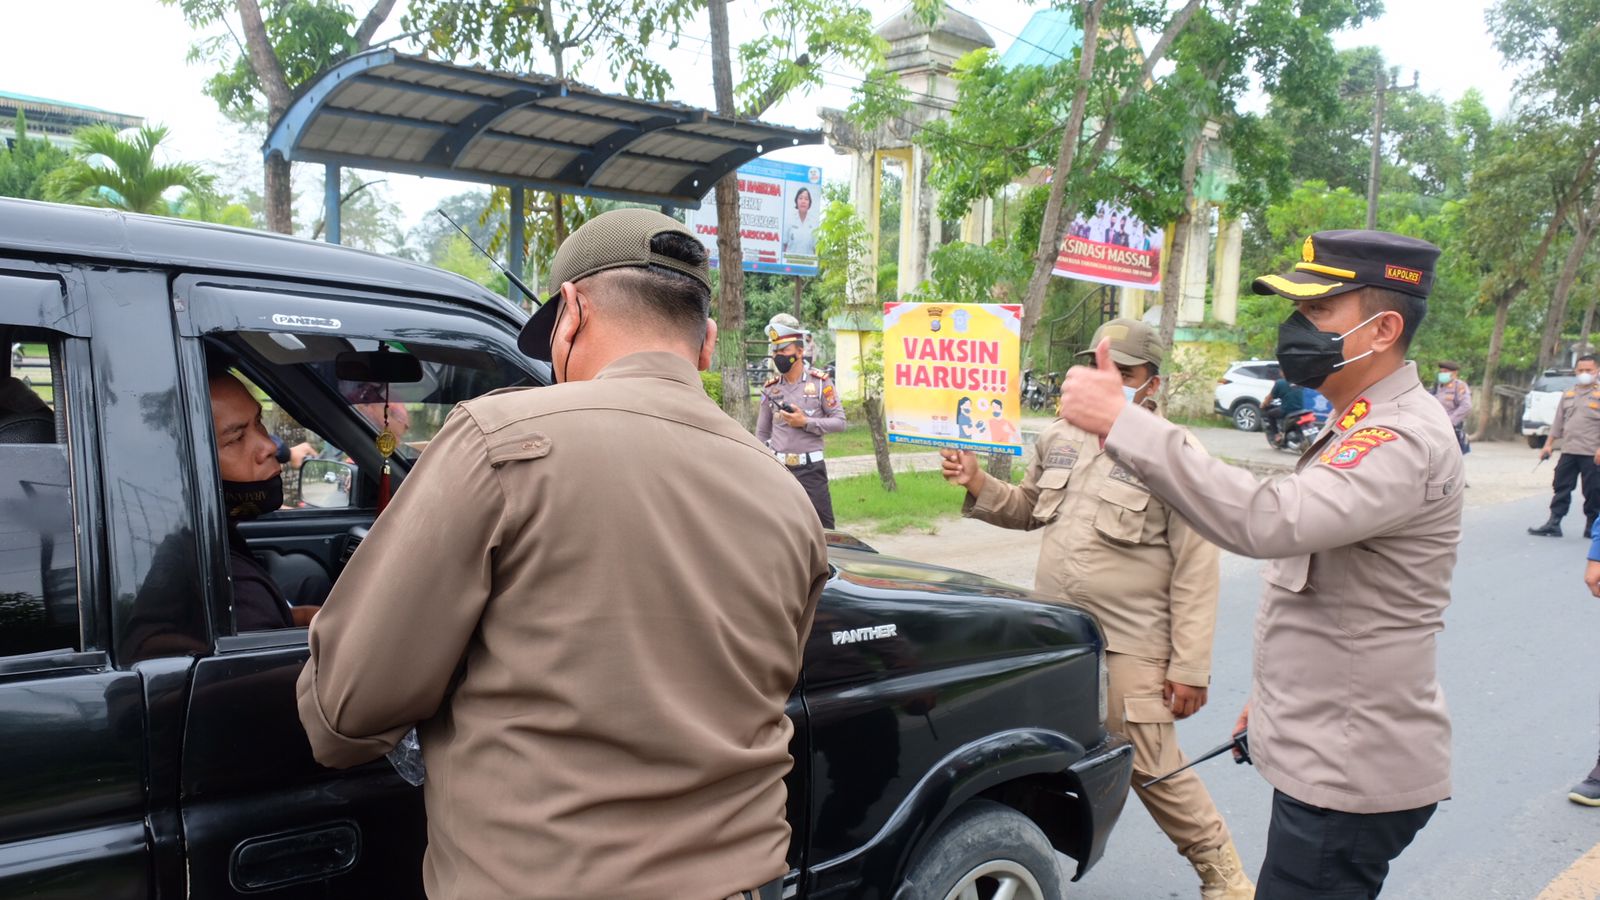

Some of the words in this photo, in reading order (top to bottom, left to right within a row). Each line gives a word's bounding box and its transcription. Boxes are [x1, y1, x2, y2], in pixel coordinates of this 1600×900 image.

[739, 229, 780, 242] ARKOBA
[1060, 239, 1106, 260] KSINASI
[1107, 248, 1152, 269] MASSAL
[1387, 268, 1420, 282] KAPOLRES
[903, 337, 998, 364] VAKSIN
[895, 364, 1006, 392] HARUS!!!
[831, 623, 897, 645] PANTHER
